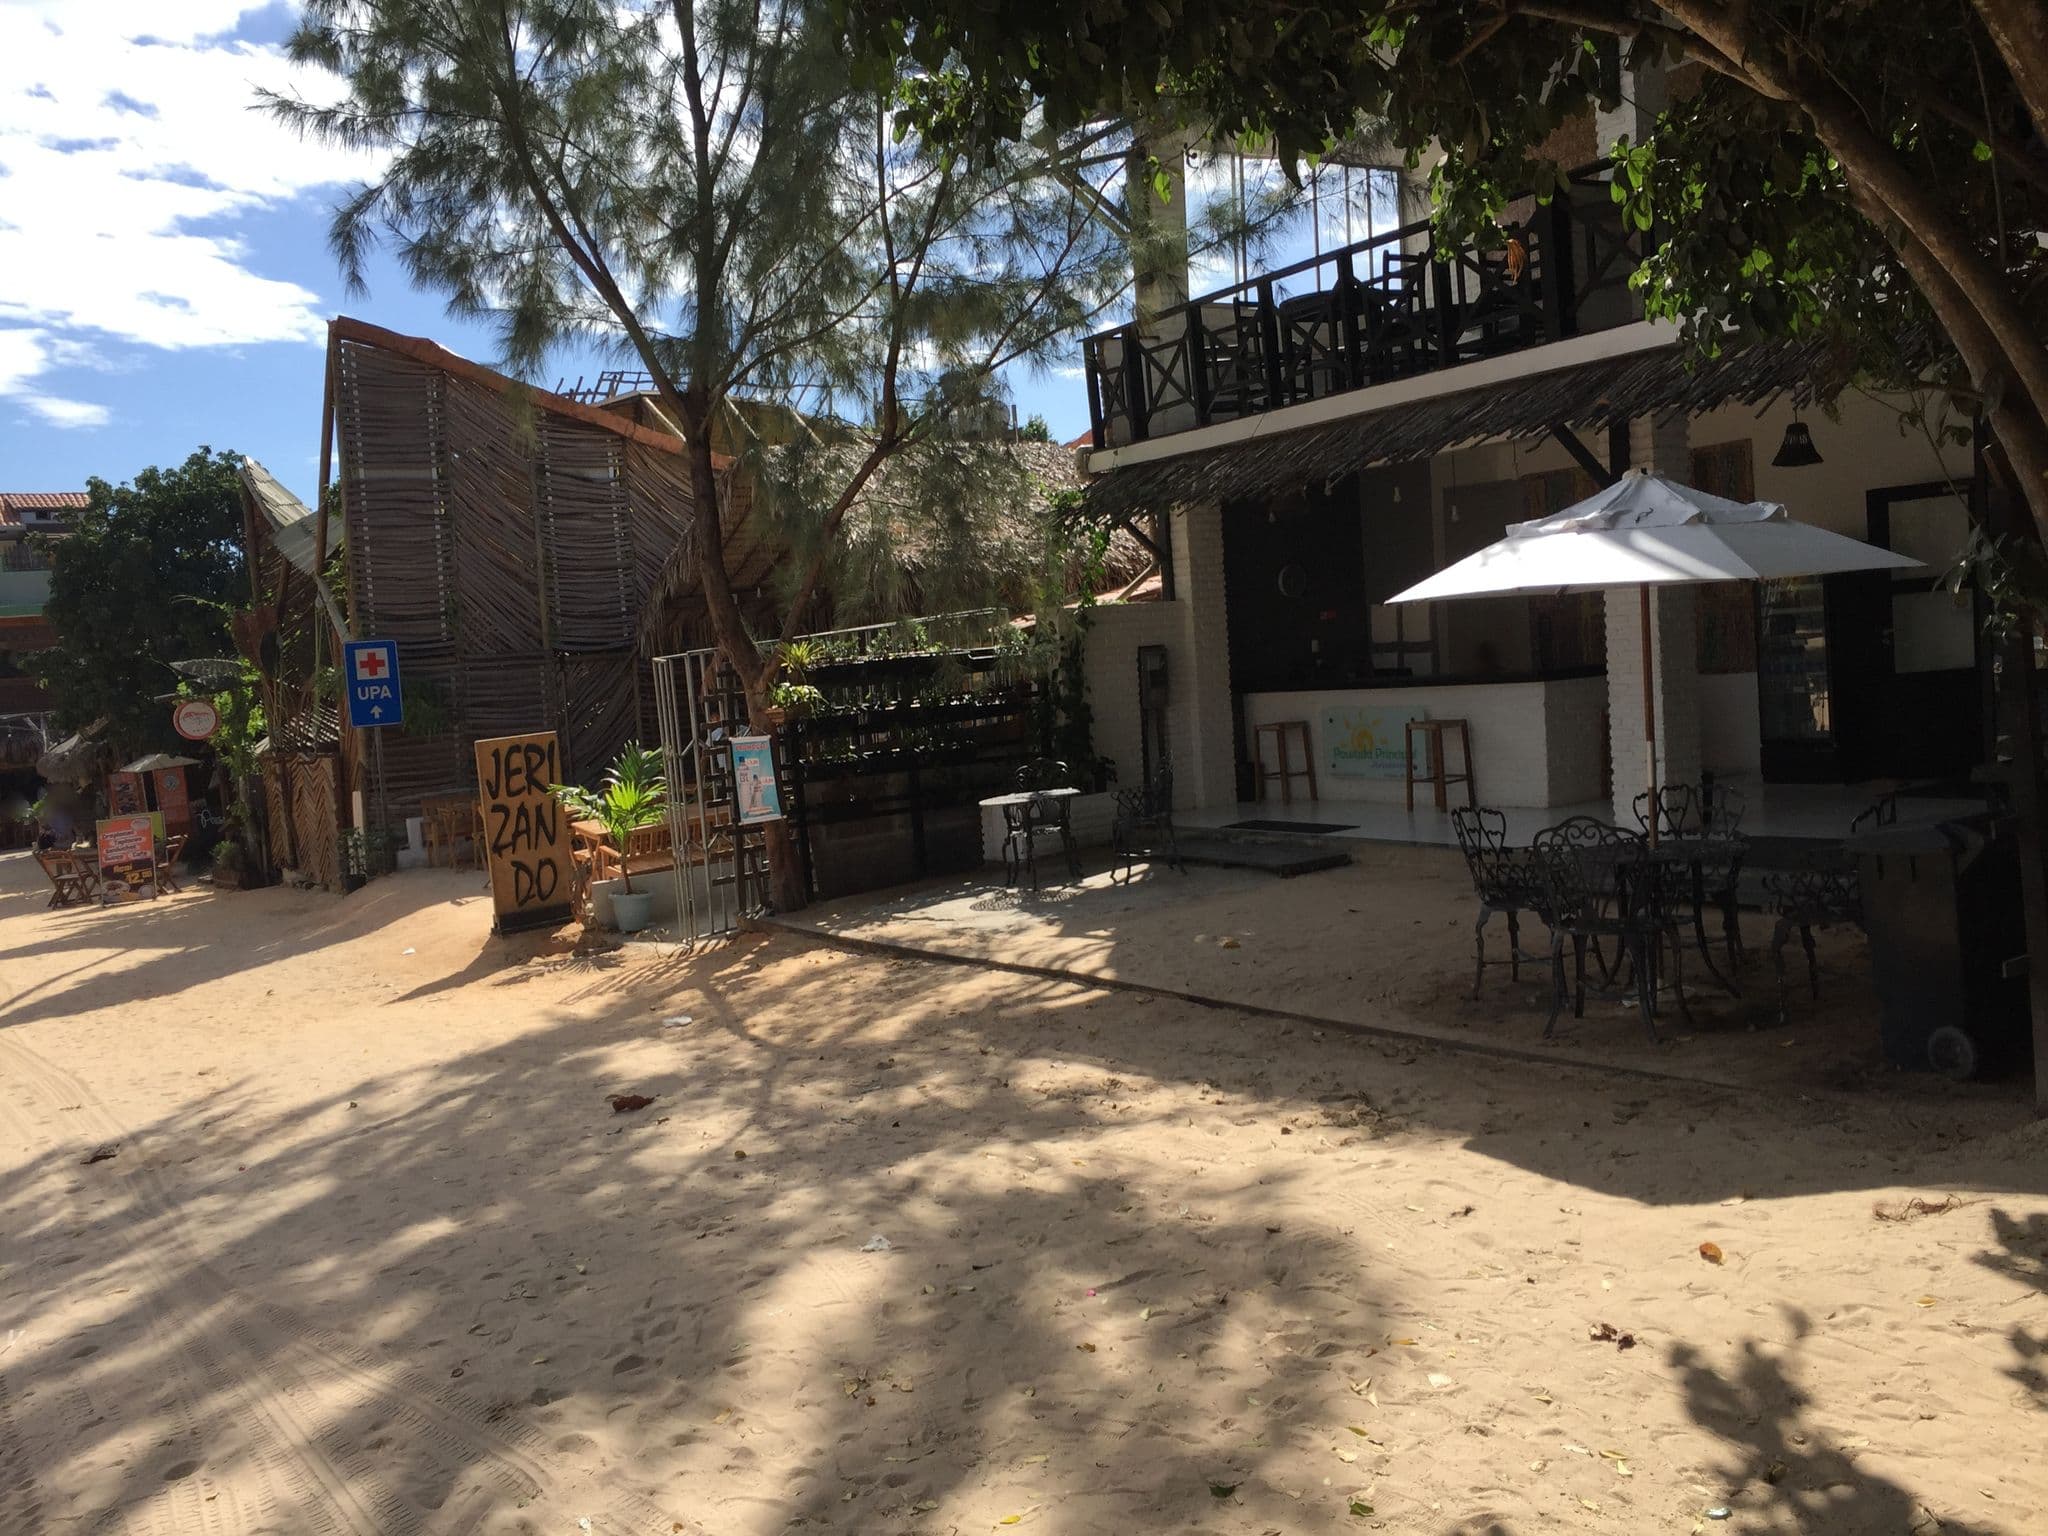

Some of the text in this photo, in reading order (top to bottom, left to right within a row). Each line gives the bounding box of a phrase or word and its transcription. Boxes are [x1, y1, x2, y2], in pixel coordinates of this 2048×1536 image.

[357, 685, 392, 700] UPA
[485, 740, 555, 800] JERI
[1333, 746, 1373, 760] Pousada
[490, 801, 557, 860] ZAN
[511, 858, 559, 907] DO
